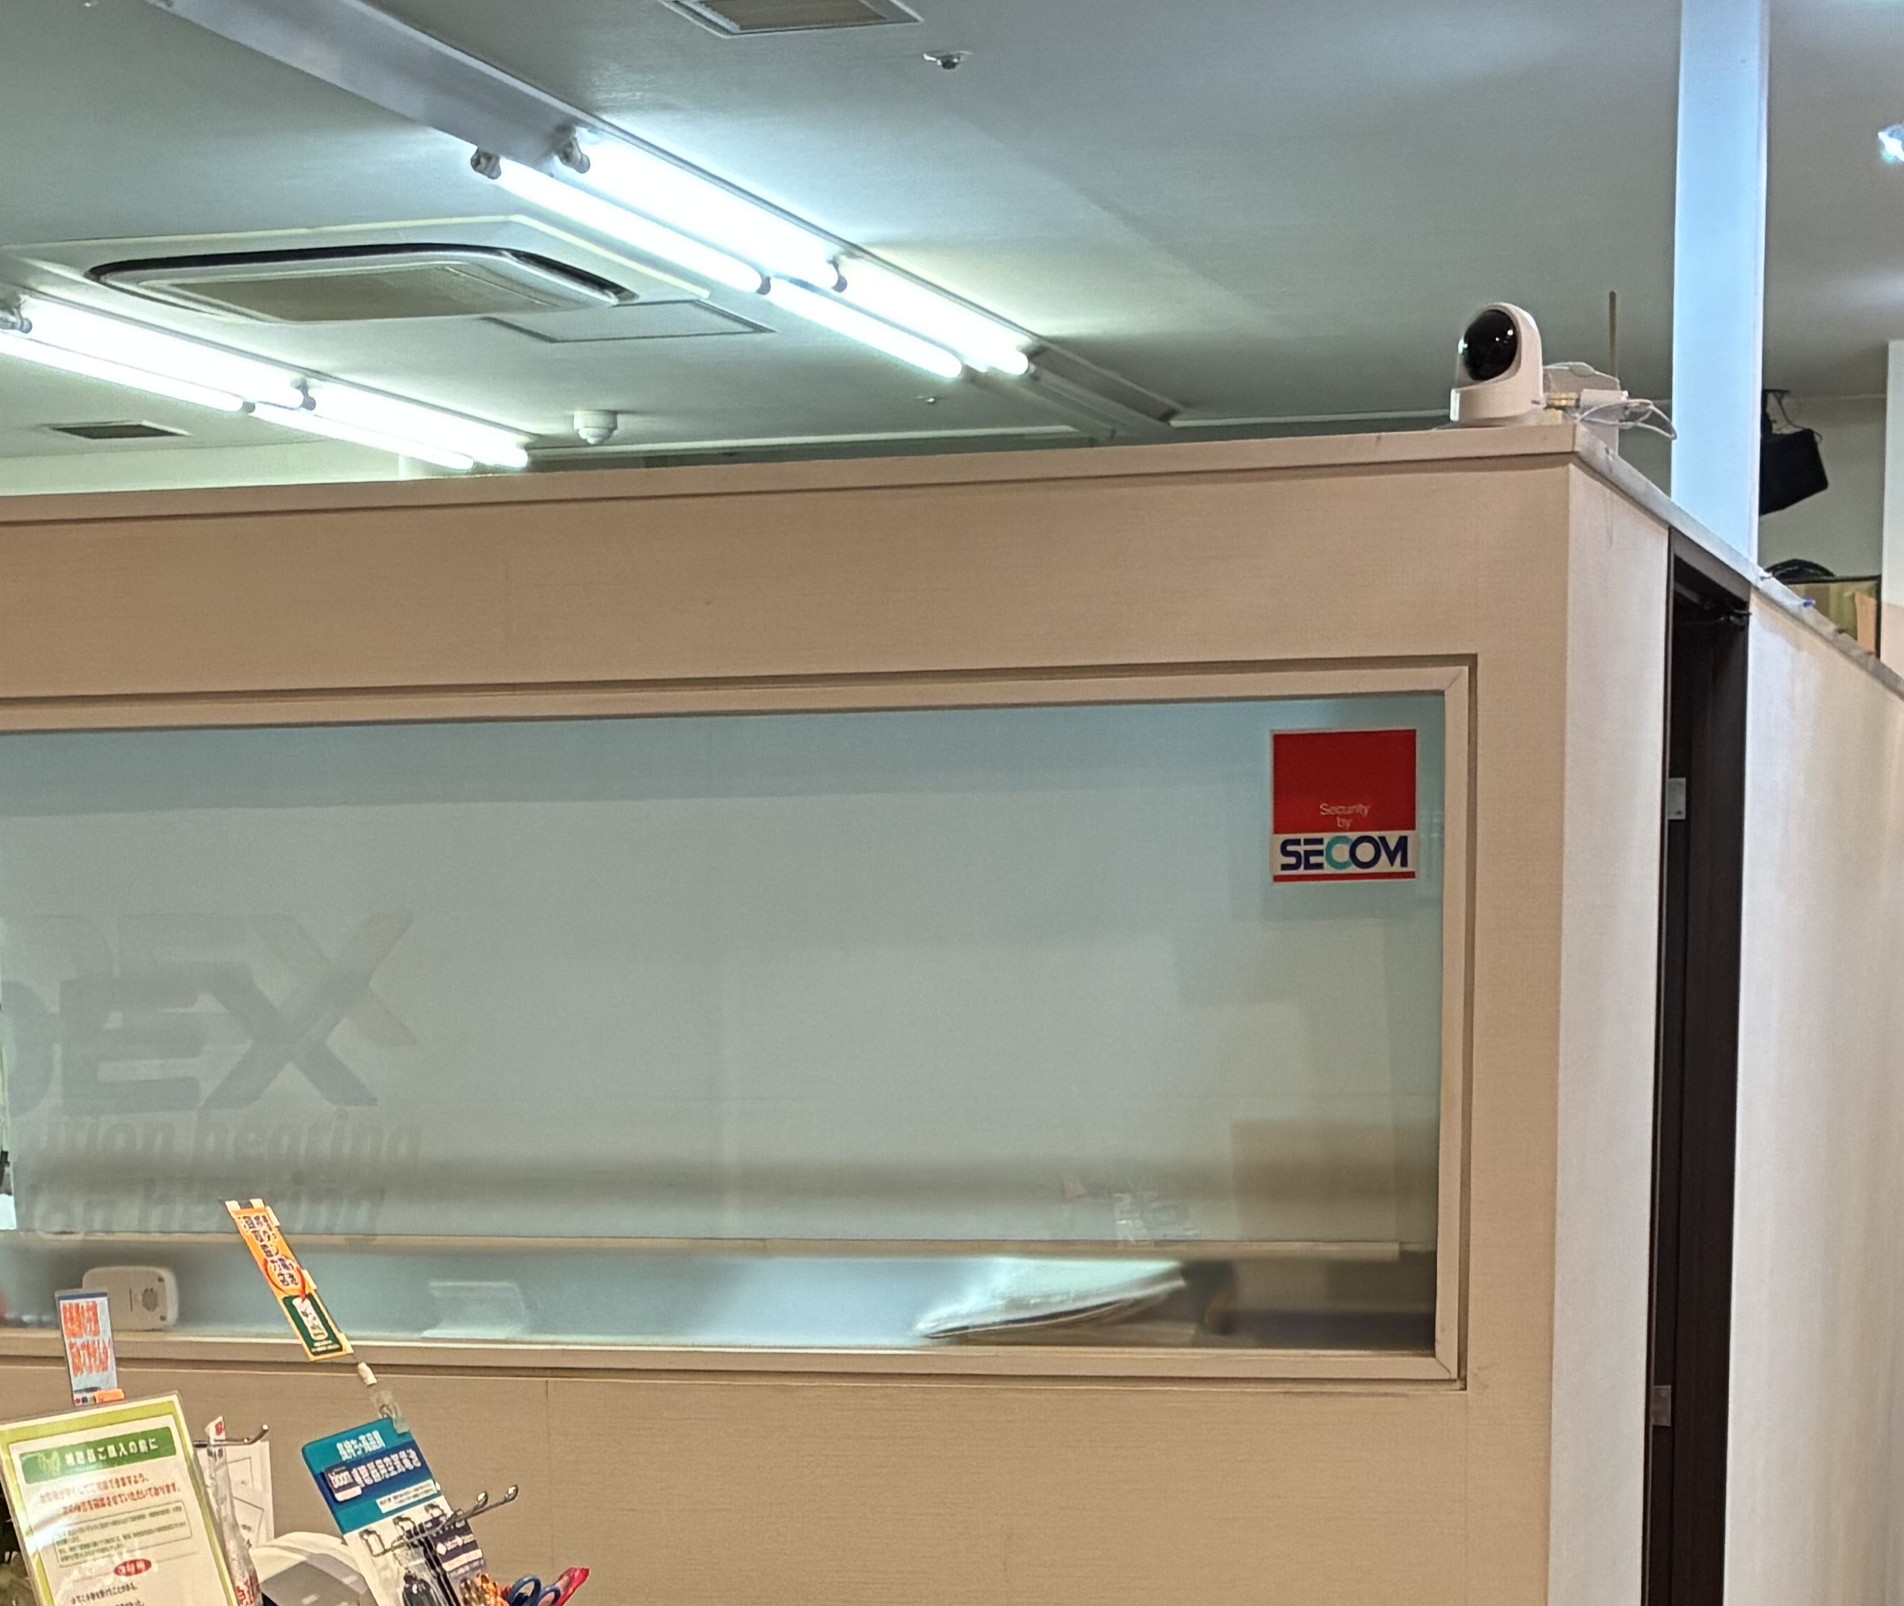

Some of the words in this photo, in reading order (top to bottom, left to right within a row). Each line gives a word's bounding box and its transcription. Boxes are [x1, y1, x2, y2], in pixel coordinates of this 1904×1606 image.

[1319, 802, 1371, 817] Security
[1336, 816, 1352, 829] by
[1280, 834, 1409, 871] SECOM
